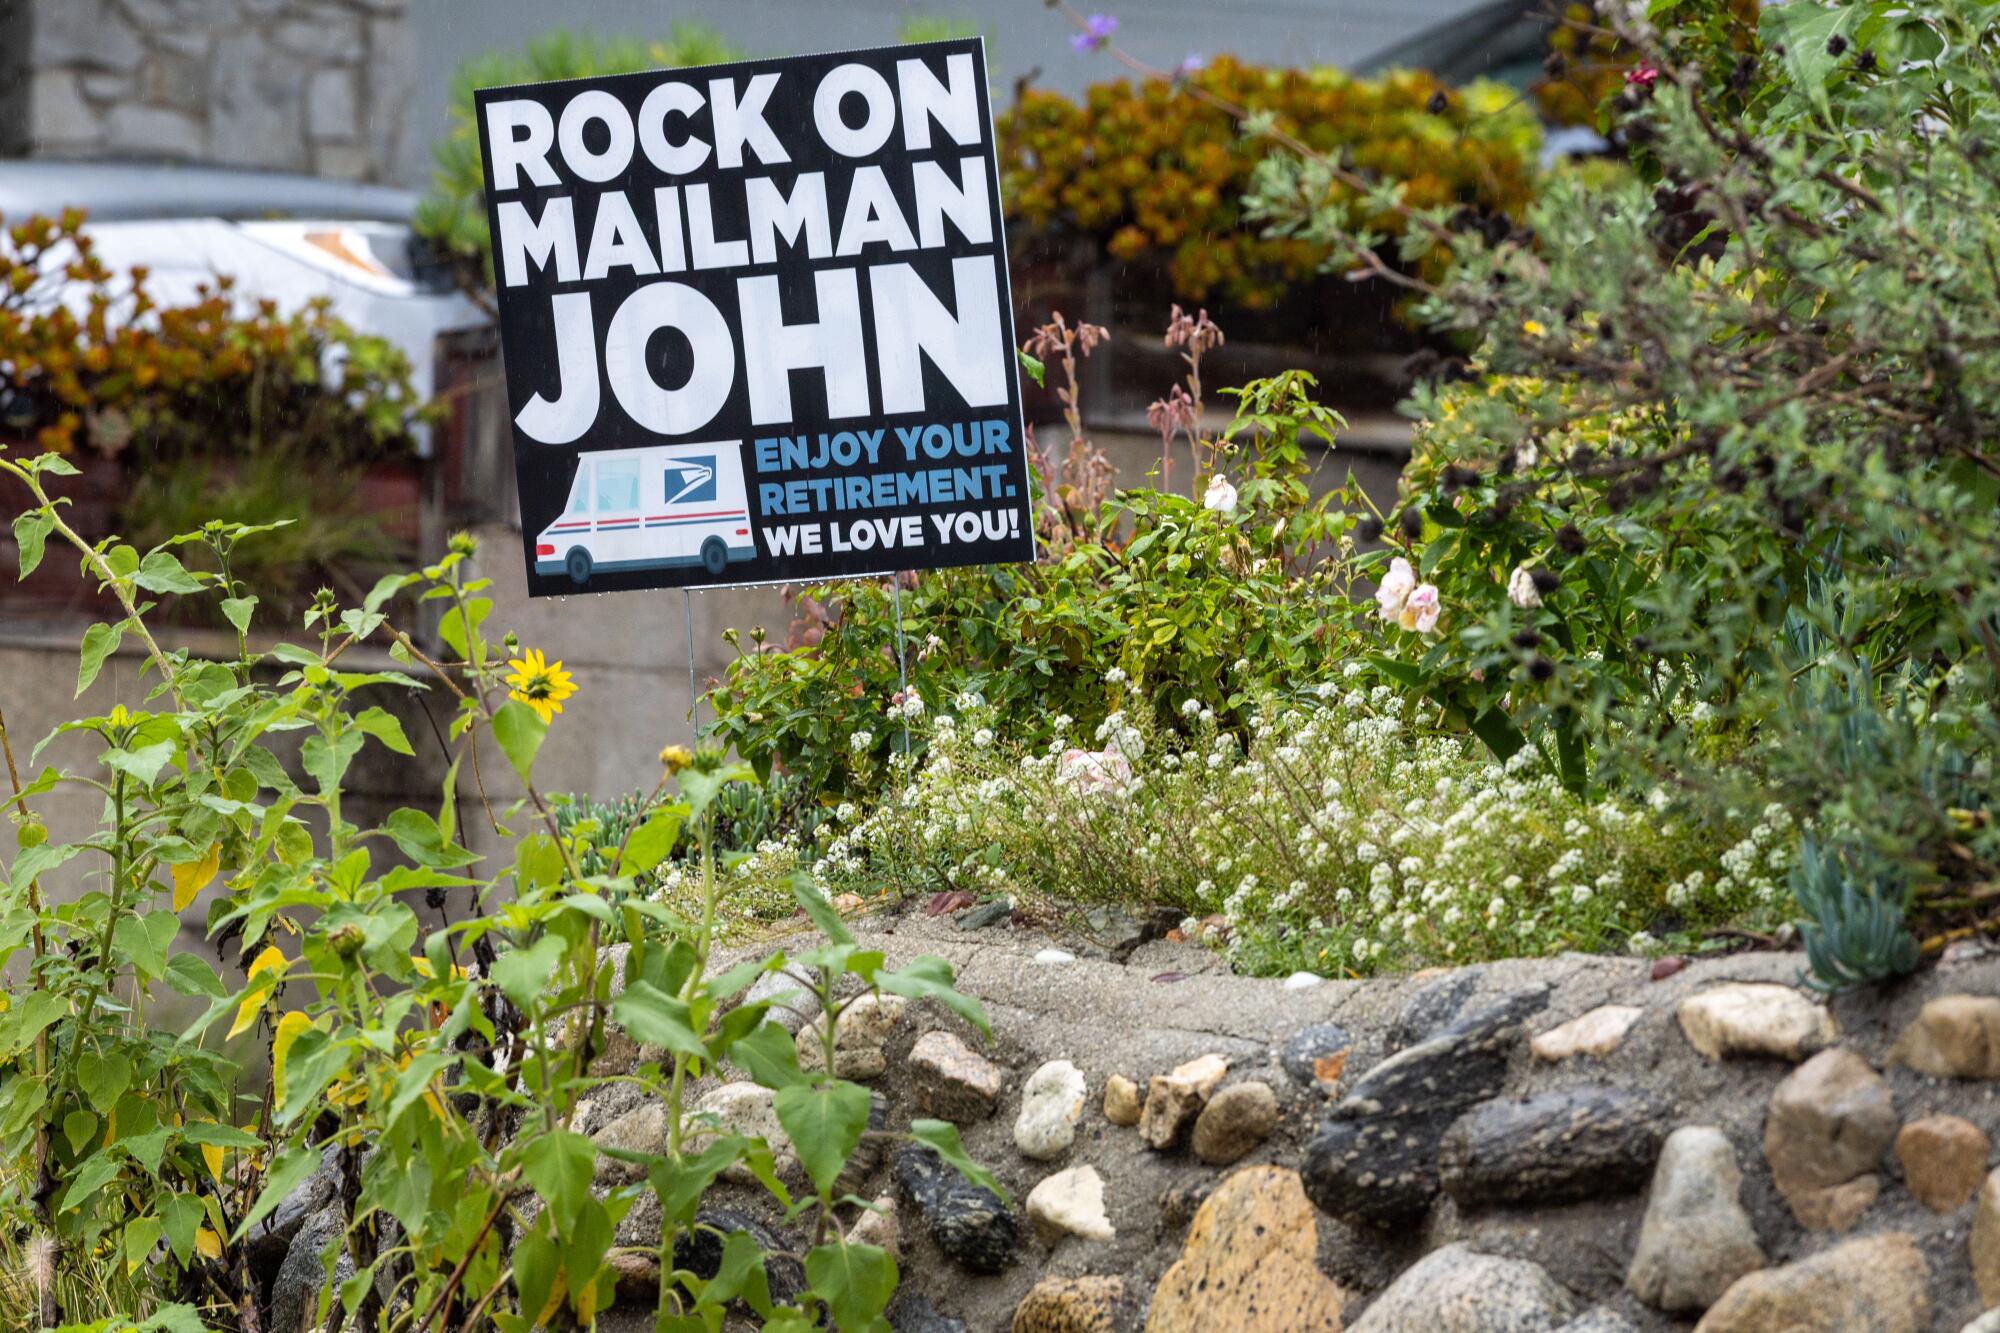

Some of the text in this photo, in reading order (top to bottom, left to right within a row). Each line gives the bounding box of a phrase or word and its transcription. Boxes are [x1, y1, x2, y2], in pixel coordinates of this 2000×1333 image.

[486, 53, 981, 191] ROCK ON
[497, 156, 993, 287] MAILMAN
[515, 255, 1008, 445] JOHN
[755, 420, 1012, 472] ENJOY YOUR
[759, 465, 1016, 517] RETIREMENT.
[762, 508, 1020, 557] WE LOVE YOU!
